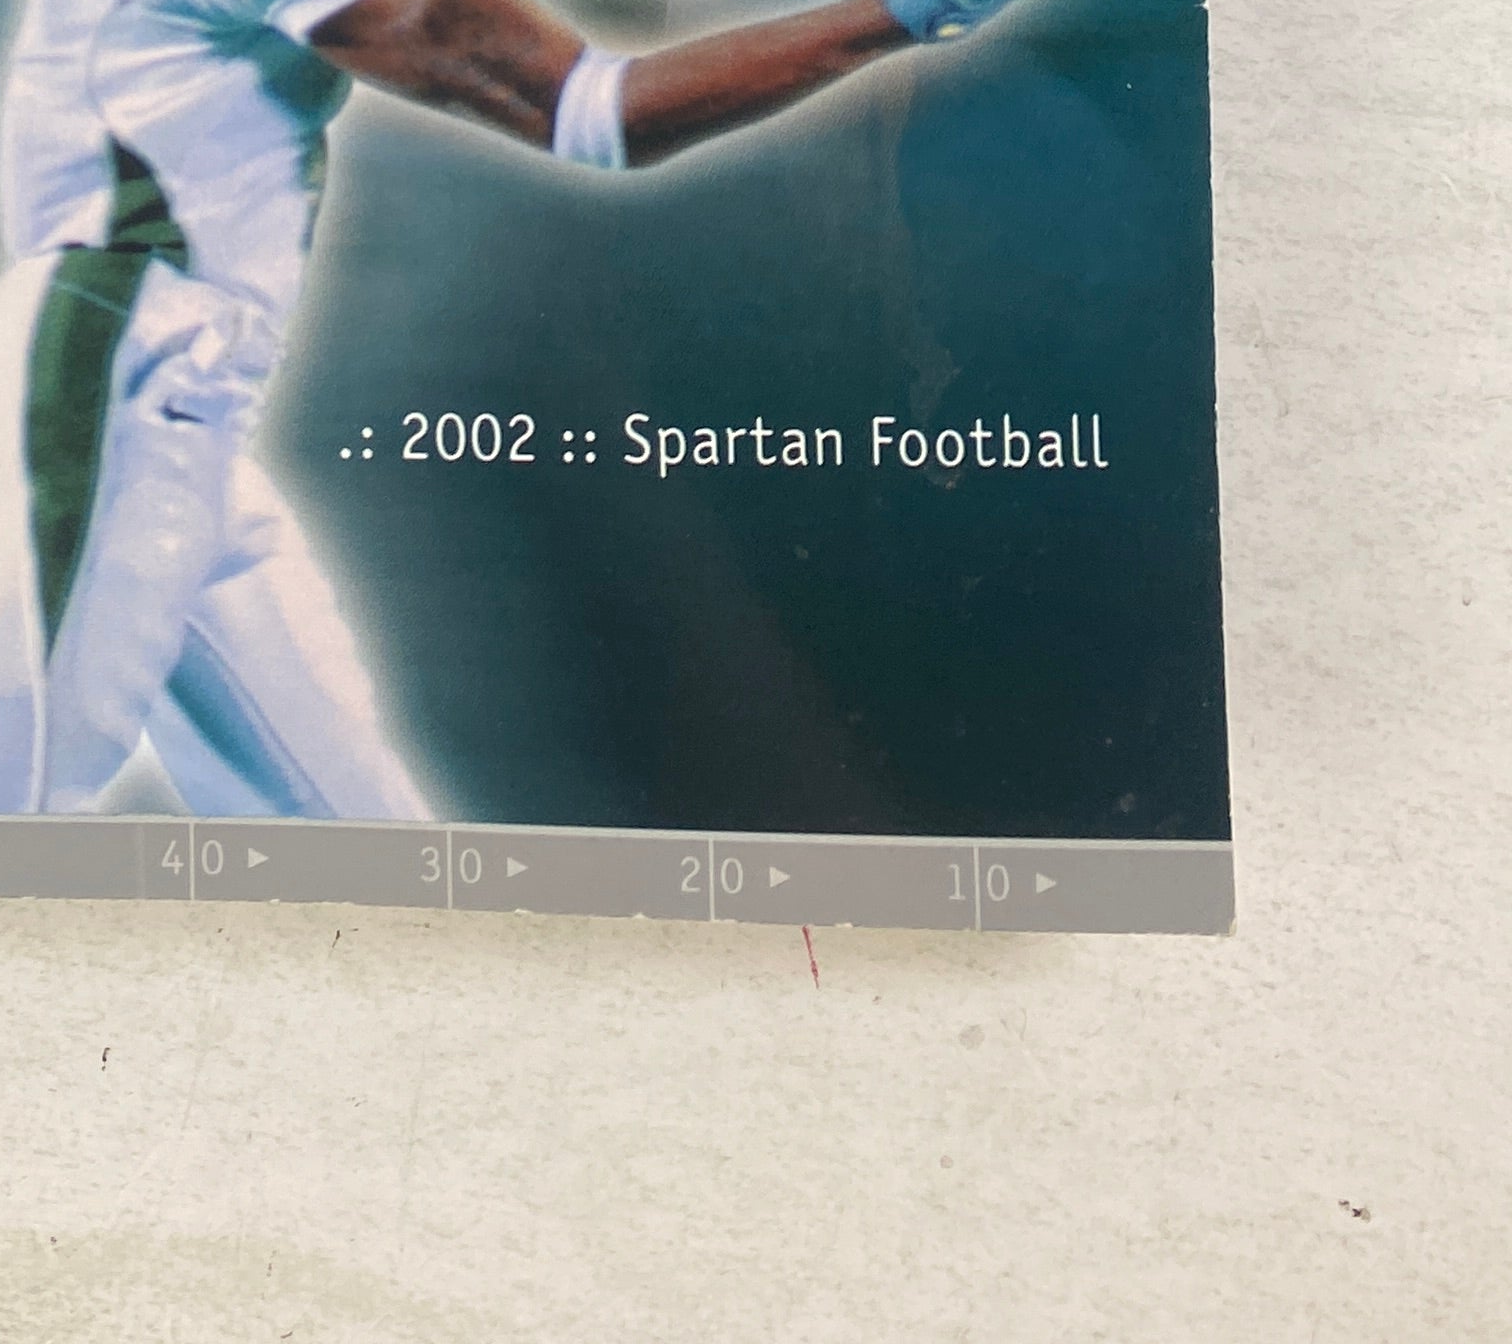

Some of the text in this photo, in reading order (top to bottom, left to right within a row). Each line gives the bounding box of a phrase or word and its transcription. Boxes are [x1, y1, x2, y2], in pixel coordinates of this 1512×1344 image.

[402, 412, 537, 464] 2002
[623, 413, 845, 478] Spartan
[870, 414, 1110, 469] Football
[160, 839, 225, 876] 40
[418, 845, 484, 885] 30
[679, 856, 744, 895] 20
[946, 863, 1011, 903] 10
